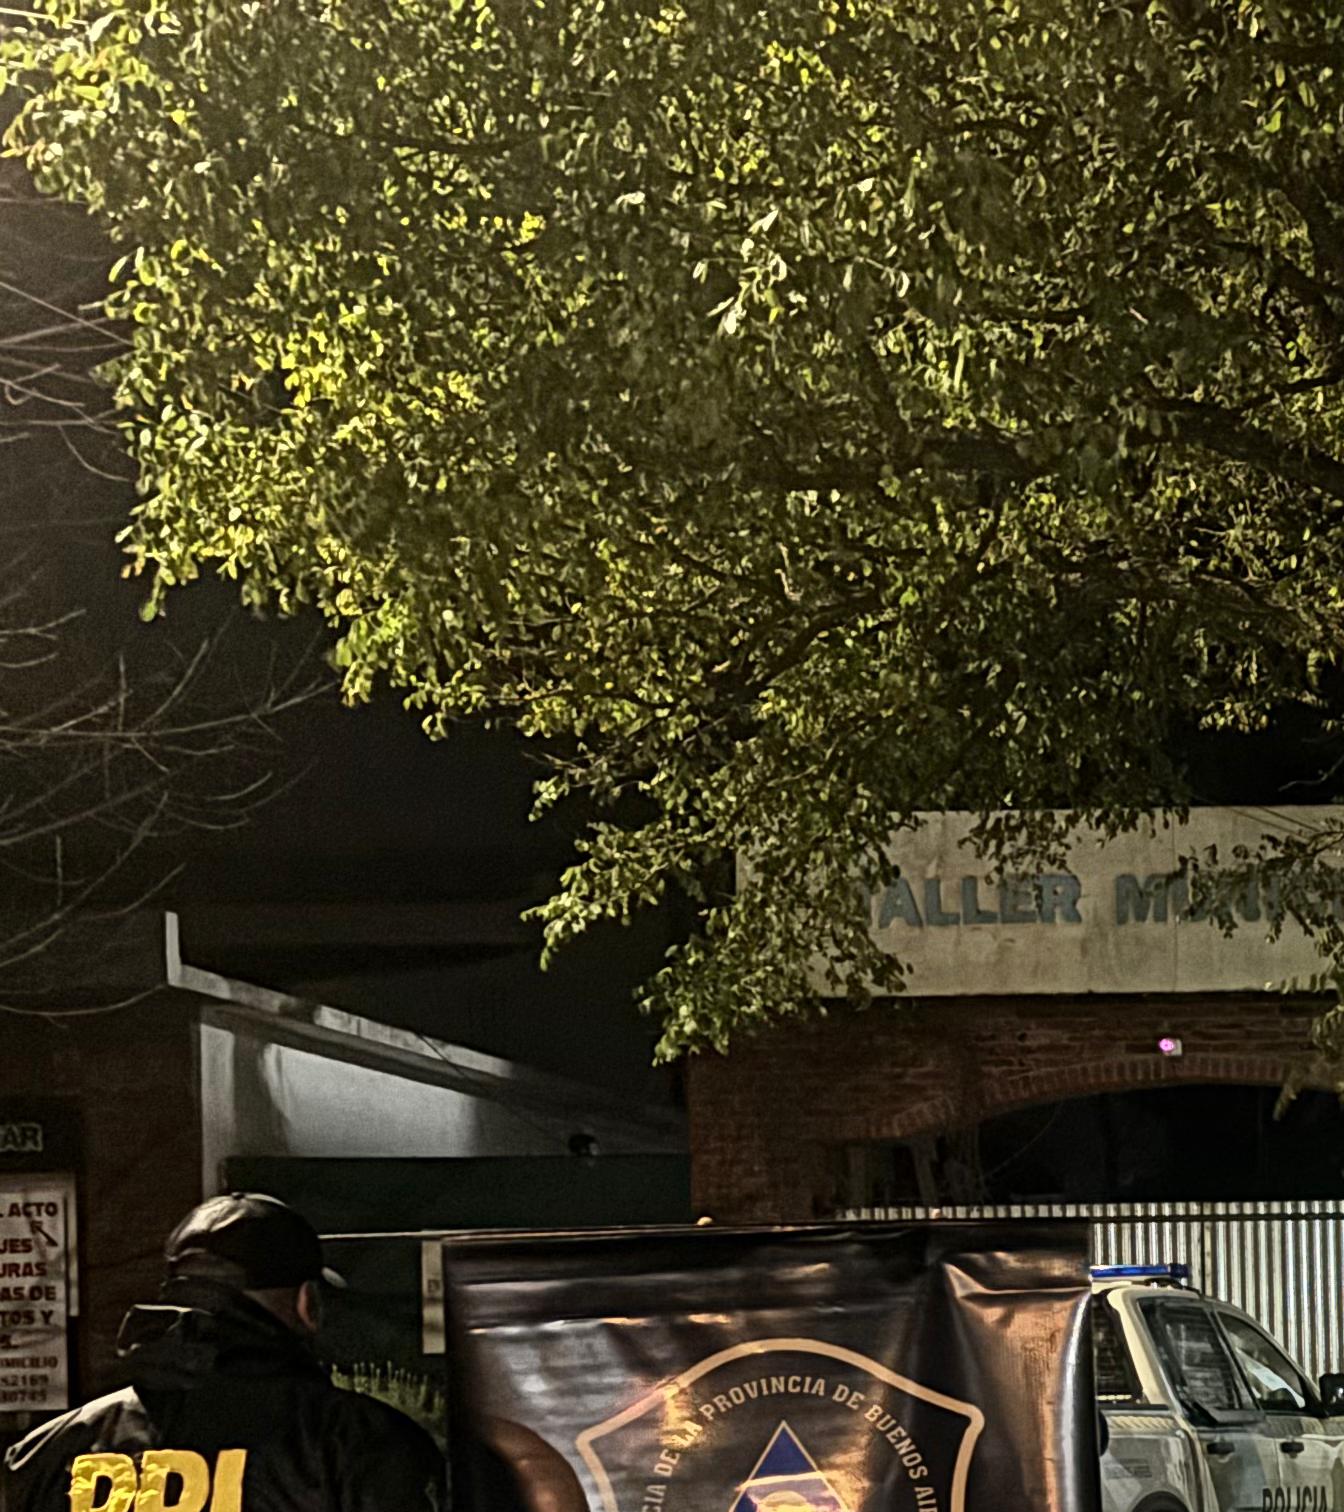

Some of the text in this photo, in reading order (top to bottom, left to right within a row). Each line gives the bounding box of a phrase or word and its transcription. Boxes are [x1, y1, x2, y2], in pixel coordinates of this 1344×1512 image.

[864, 873, 1082, 928] ALLER
[9, 1202, 58, 1218] ACTO
[40, 1310, 54, 1326] Y
[652, 1447, 680, 1478] DE
[674, 1419, 703, 1448] LA
[699, 1375, 826, 1421] PROVINCIA
[832, 1383, 862, 1410] DE
[863, 1404, 929, 1485] BUENOS
